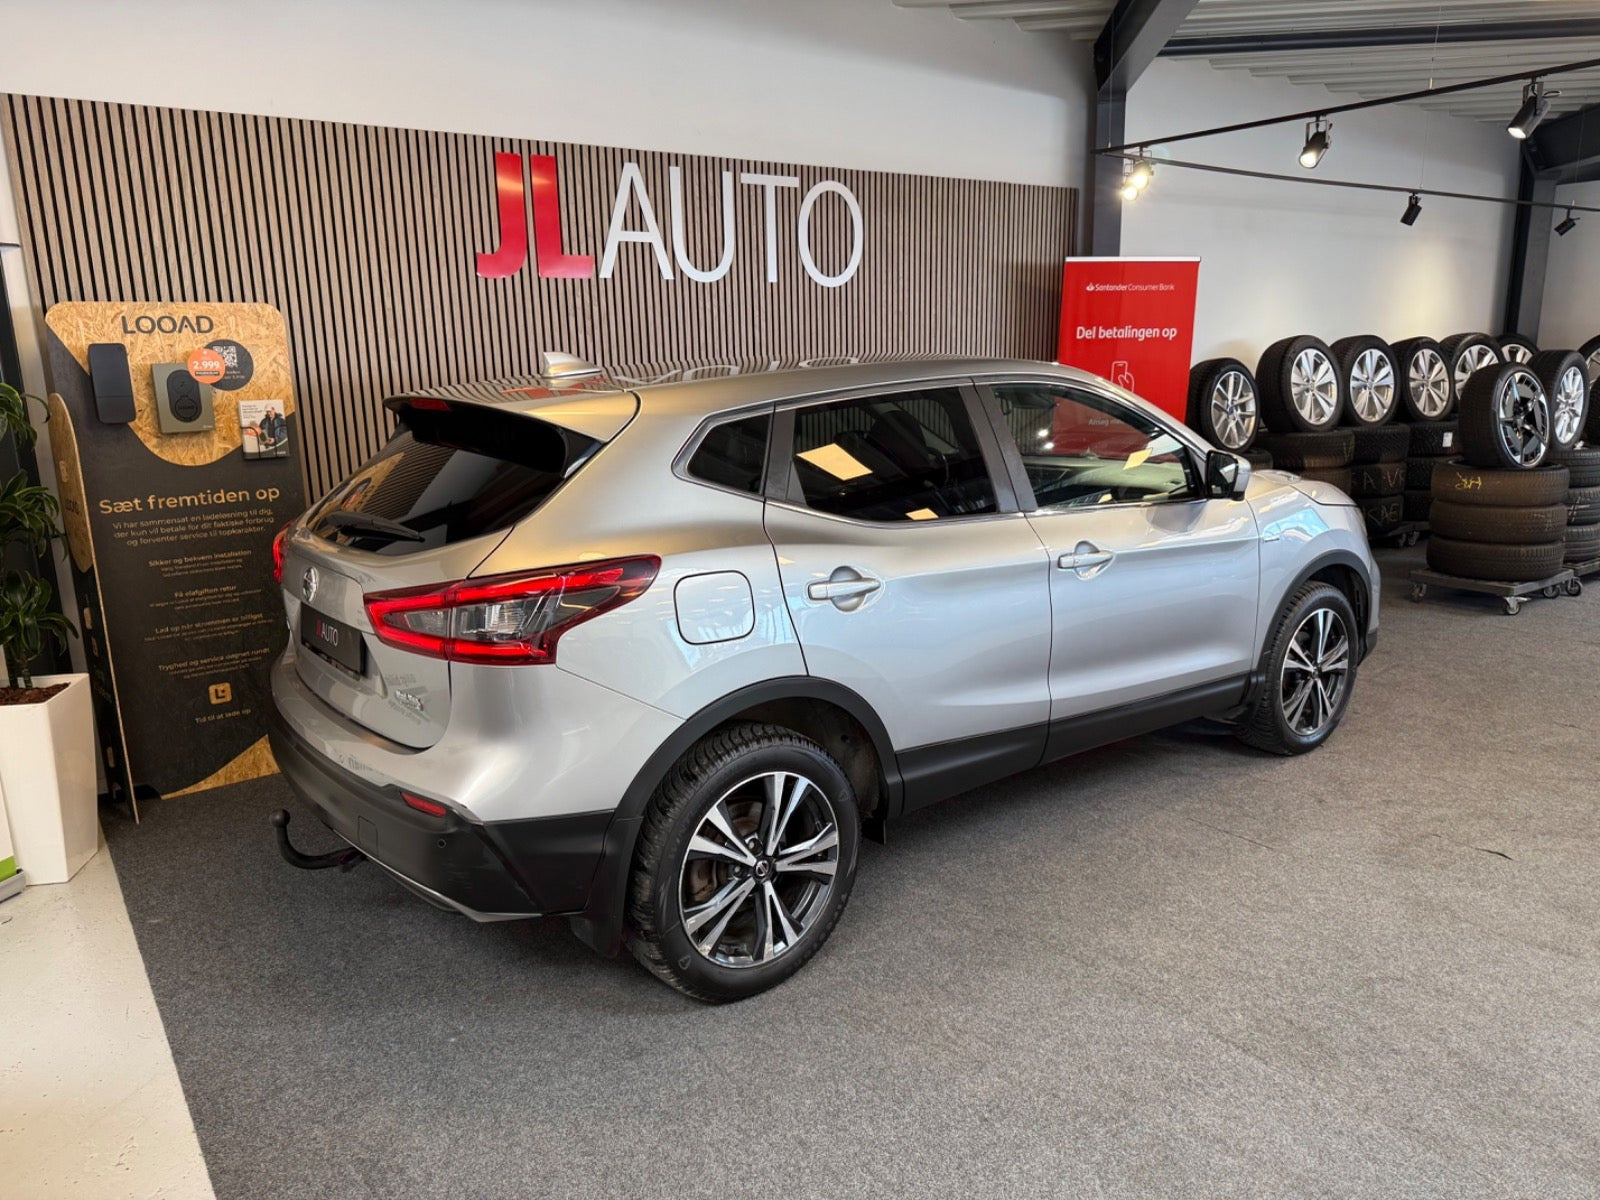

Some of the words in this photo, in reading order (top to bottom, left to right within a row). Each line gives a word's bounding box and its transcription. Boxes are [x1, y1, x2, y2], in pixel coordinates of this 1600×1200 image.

[1076, 326, 1096, 339] Del
[1098, 325, 1160, 342] betalingen
[1162, 328, 1178, 340] op
[192, 360, 220, 370] 2.999
[100, 498, 143, 514] Sæt
[147, 489, 250, 510] fremtiden
[255, 487, 280, 502] op
